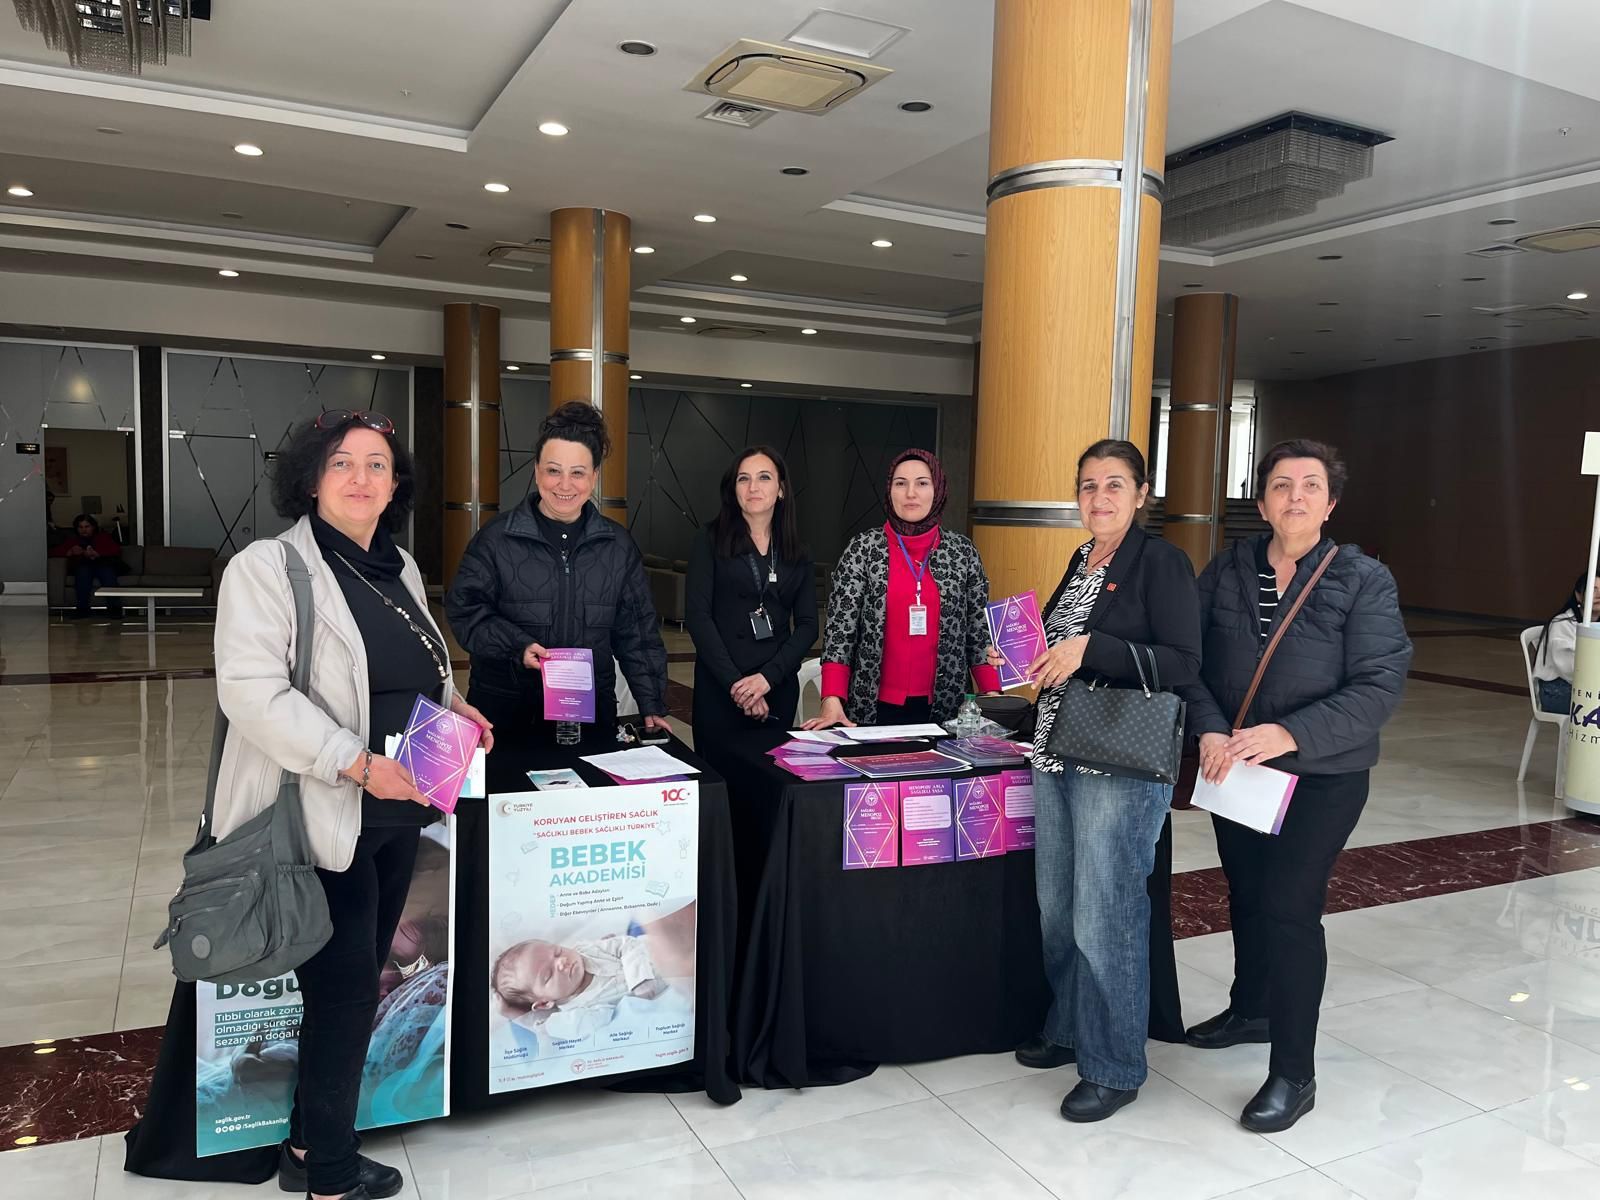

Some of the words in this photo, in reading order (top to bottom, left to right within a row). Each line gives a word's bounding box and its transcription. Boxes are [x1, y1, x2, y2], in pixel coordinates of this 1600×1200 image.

[534, 816, 577, 826] KORUYAN
[578, 811, 627, 823] GELİŞTİREN
[629, 809, 658, 819] SAĞLIK
[595, 824, 626, 833] SAĞLIKLI
[550, 840, 646, 869] BEBEK
[550, 861, 646, 887] AKADEMİSİ
[216, 1013, 241, 1022] Tıbbi
[244, 1009, 276, 1018] olarak
[216, 1023, 261, 1034] olmadığı
[264, 1018, 298, 1028] sürece
[216, 1034, 262, 1046] sezaryen
[266, 1030, 294, 1040] doğal
[215, 1114, 250, 1124] saglik.gov.tr
